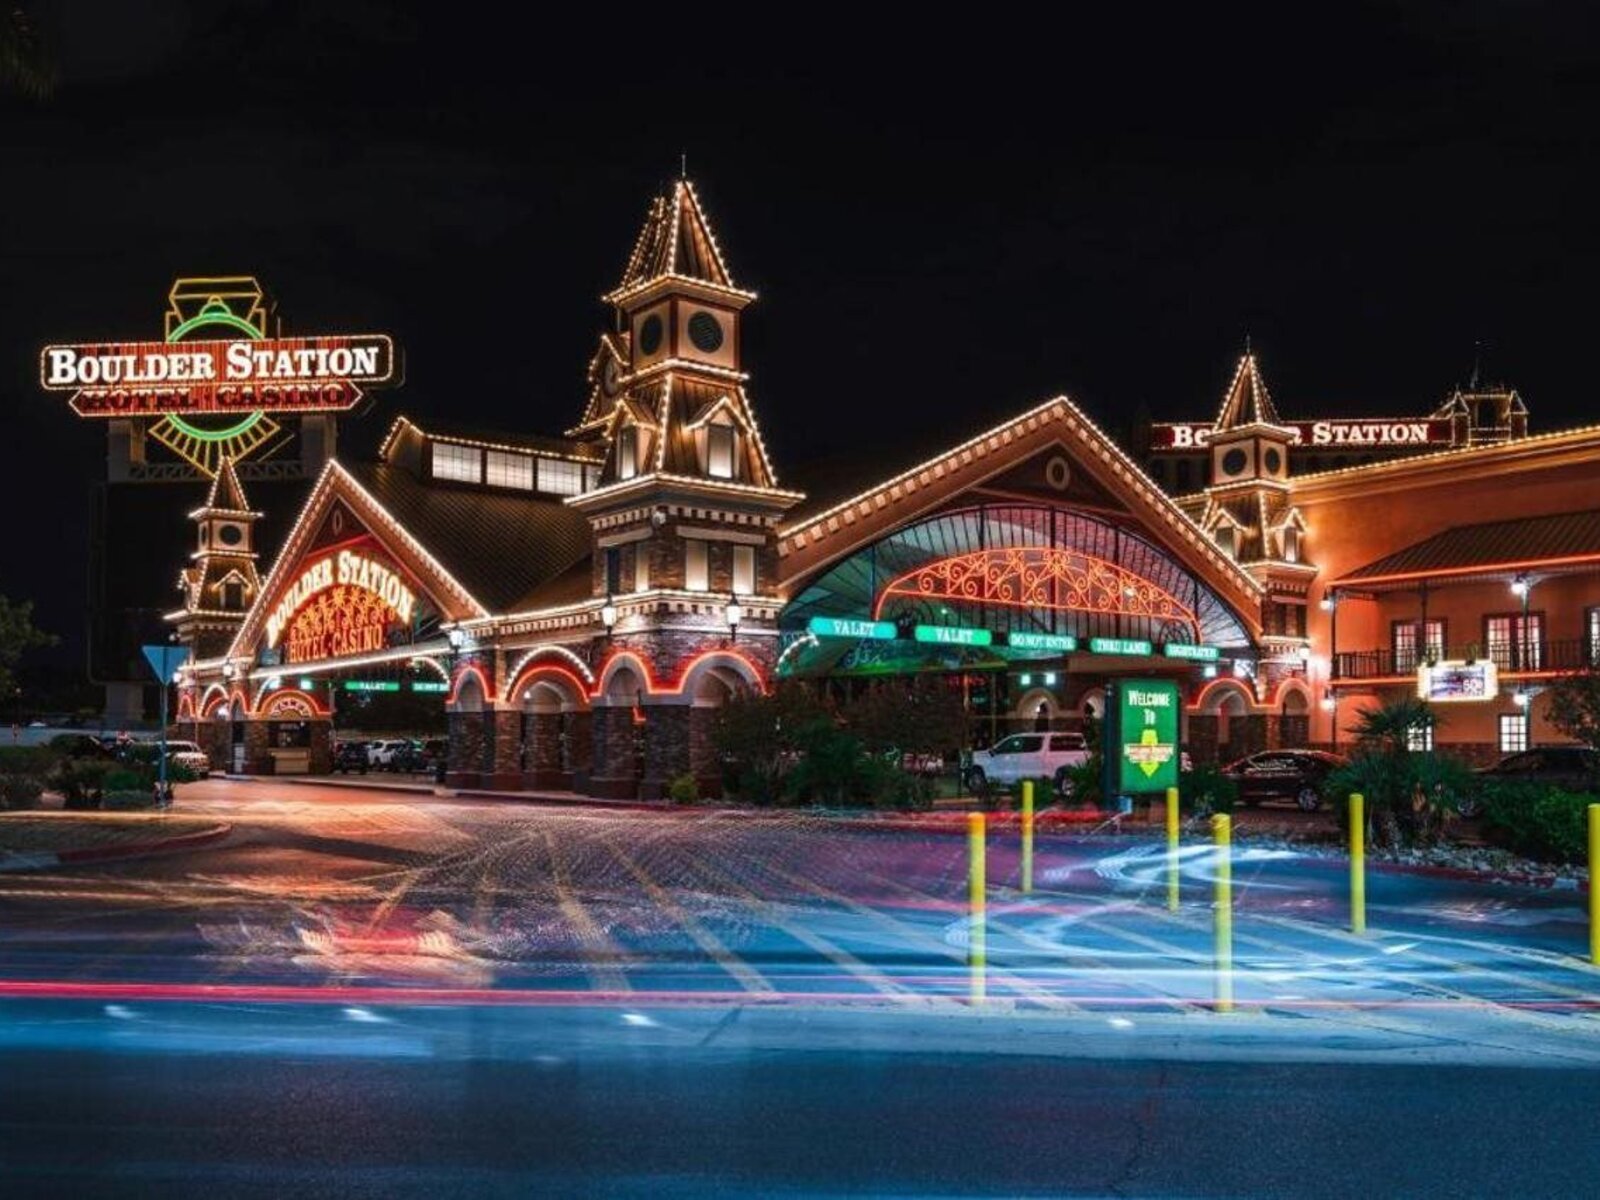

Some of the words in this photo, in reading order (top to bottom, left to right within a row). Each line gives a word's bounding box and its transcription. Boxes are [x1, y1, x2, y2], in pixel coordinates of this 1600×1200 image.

[48, 349, 216, 385] BOULDER
[226, 342, 379, 379] STATION
[1312, 421, 1429, 444] STATION
[265, 557, 333, 649] BOULDER
[338, 549, 417, 625] STATION
[833, 620, 876, 637] VALET
[934, 627, 974, 643] VALET
[289, 633, 327, 663] HOTEL
[332, 624, 383, 657] CASINO
[1127, 689, 1171, 707] WELCOME
